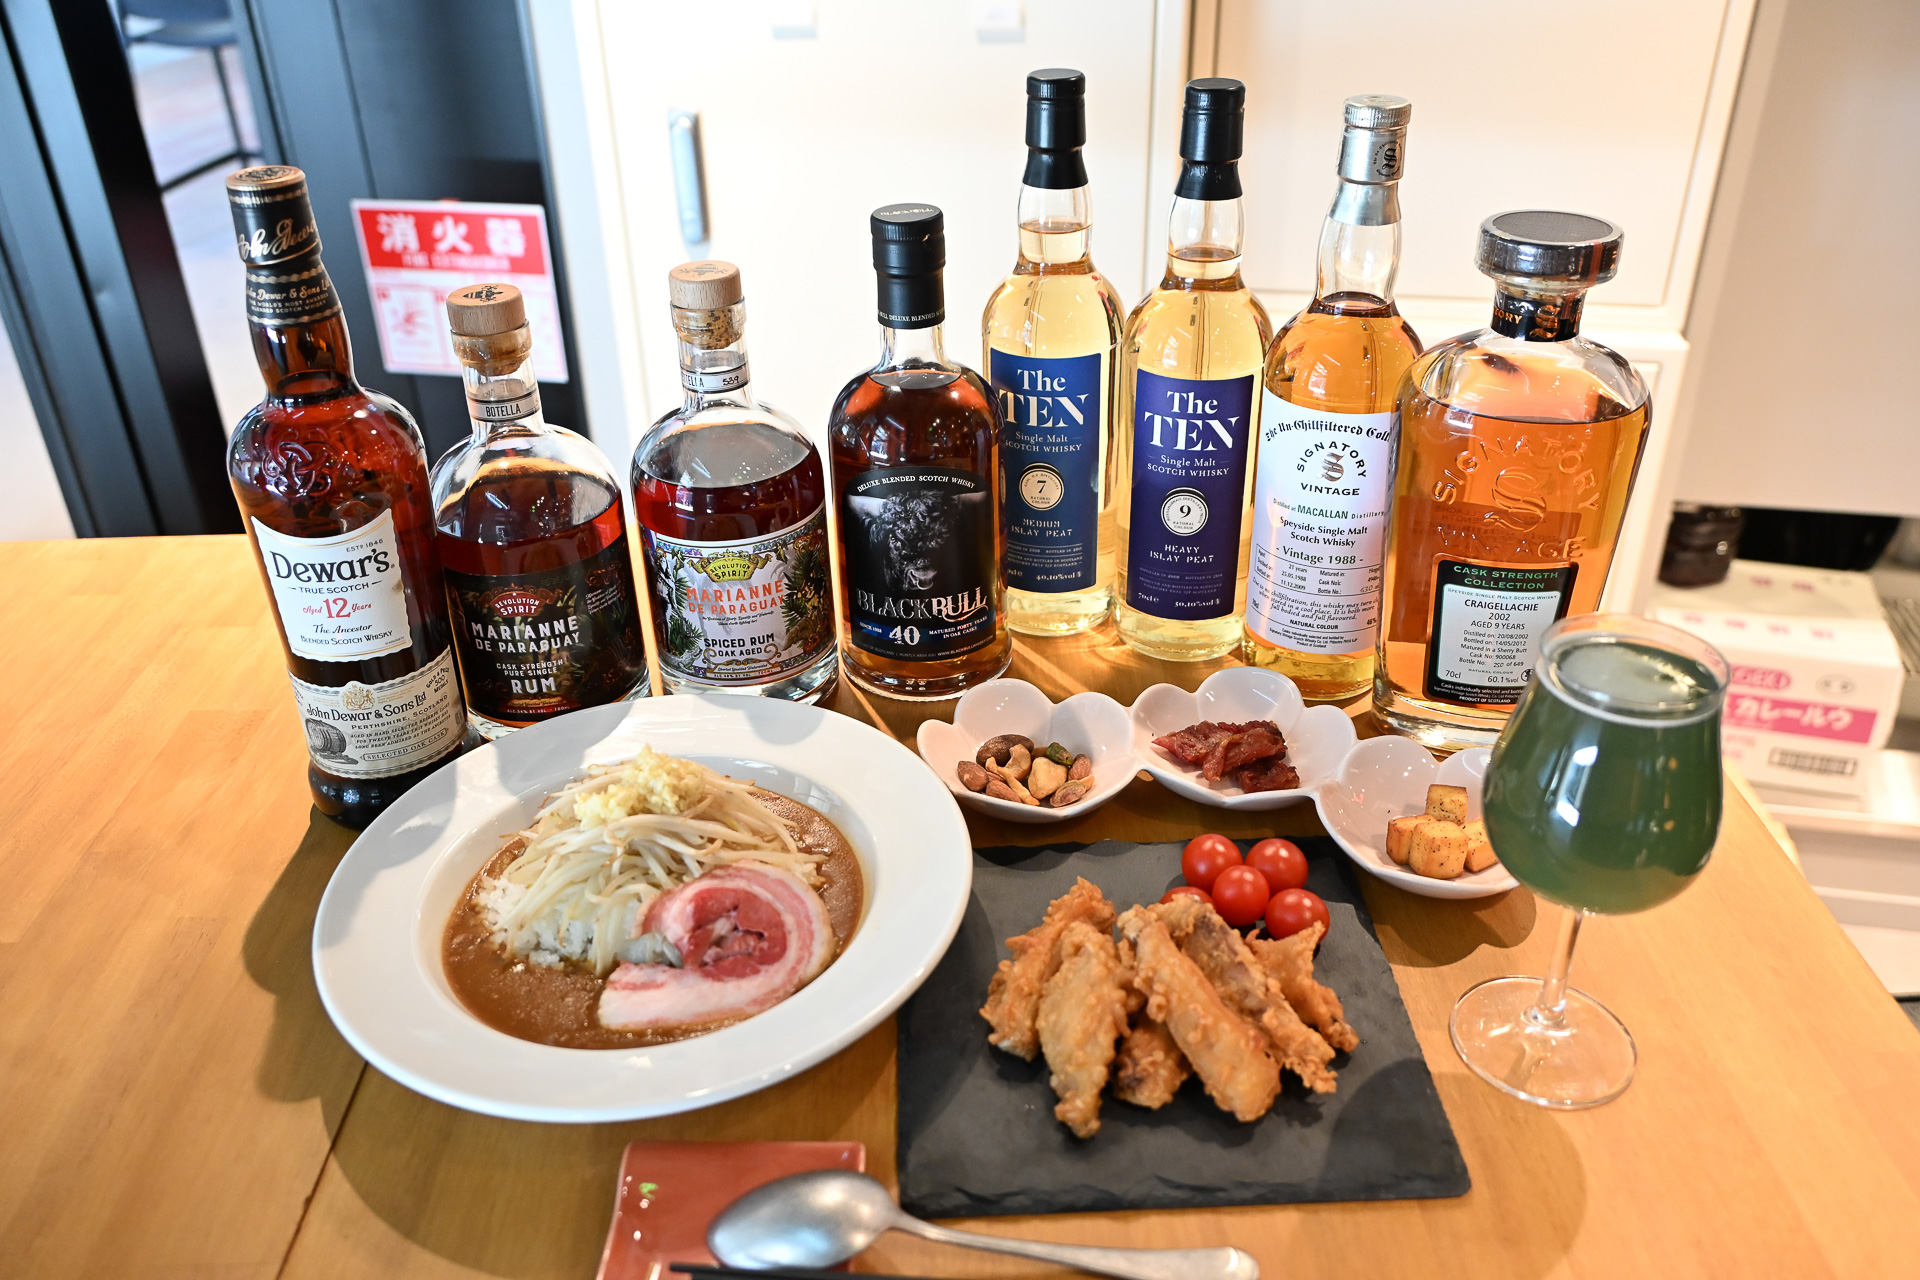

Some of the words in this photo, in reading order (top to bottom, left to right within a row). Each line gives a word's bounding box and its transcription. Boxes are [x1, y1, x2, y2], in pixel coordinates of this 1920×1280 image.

[376, 212, 527, 258] 消火器
[889, 314, 910, 322] DELUXE
[912, 313, 935, 321] BLENDED
[1017, 369, 1067, 392] The
[1000, 389, 1089, 428] TEN
[1166, 390, 1218, 415] The
[486, 404, 521, 417] BOTELLA
[1015, 431, 1043, 443] Single
[1048, 433, 1068, 442] Malt
[1144, 411, 1239, 451] TEN
[1004, 440, 1040, 452] SCOTCH
[1043, 443, 1082, 453] WHISKY
[1161, 454, 1191, 467] Single
[1194, 457, 1216, 466] Malt
[1297, 441, 1366, 478] SIGNATORY
[1147, 462, 1186, 476] SCOTCH
[1190, 467, 1230, 477] WHISKY
[1433, 435, 1599, 510] SIGNATORY
[858, 480, 880, 493] DELUXE
[882, 475, 916, 485] BLENDED
[952, 478, 976, 489] WHISKY
[1037, 480, 1046, 493] 7
[1301, 482, 1360, 496] VINTAGE
[1179, 505, 1191, 518] 9
[1298, 505, 1348, 519] MACALLAN
[1351, 511, 1384, 519] Distillery
[1023, 519, 1060, 528] MEDIUM
[1280, 516, 1315, 532] Speyside
[1318, 526, 1345, 536] Single
[1348, 526, 1368, 535] Malt
[1011, 526, 1039, 536] ISLAY
[1046, 529, 1072, 537] PEAT
[365, 539, 383, 548] 1846
[1291, 532, 1320, 544] Scotch
[1323, 538, 1356, 548] Whisky
[1165, 544, 1200, 553] HEAVY
[1150, 551, 1180, 562] ISLAY
[1187, 555, 1214, 563] PEAT
[1283, 546, 1324, 564] Vintage
[1328, 555, 1356, 565] 1988
[270, 549, 390, 583] Dewar's
[710, 563, 750, 572] REVOLUTION
[1453, 565, 1488, 577] CASK
[1492, 571, 1559, 579] STRENGTH
[715, 570, 748, 579] SPIRIT
[298, 586, 325, 594] TRUE
[326, 582, 369, 594] SCOTCH
[1464, 577, 1545, 589] COLLECTION
[686, 579, 783, 602] MARIANNE
[302, 604, 323, 615] Aged
[323, 597, 352, 619] 12
[352, 603, 372, 612] Years
[495, 598, 540, 608] REVOLUTION
[689, 603, 704, 613] DE
[711, 594, 784, 614] PARAGUAY
[1271, 596, 1287, 605] stored
[1315, 607, 1332, 616] place.
[1323, 602, 1345, 610] whisky
[1464, 599, 1539, 612] CRAIGELLACHIE
[500, 606, 536, 616] SPIRIT
[1489, 613, 1511, 621] 2002
[313, 624, 330, 634] The
[332, 624, 372, 634] Ancestor
[471, 616, 579, 640] MARIANNE
[1290, 619, 1315, 628] NATURAL
[1471, 620, 1493, 629] AGED
[300, 635, 330, 645] BLENDED
[331, 637, 363, 645] SCOTCH
[364, 630, 393, 642] WHISKY
[889, 625, 921, 645] 40
[929, 627, 955, 635] MATURED
[1464, 629, 1486, 638] Distilled
[476, 639, 492, 651] DE
[499, 632, 579, 653] PARAGUAY
[704, 638, 745, 648] SPICED
[750, 633, 774, 646] RUM
[739, 647, 762, 656] AGED
[1461, 644, 1484, 652] Matured
[521, 659, 563, 670] STRENGTH
[1459, 657, 1475, 665] Bottle
[528, 667, 557, 676] SINGLE
[1445, 670, 1462, 679] 70cl
[511, 677, 556, 694] RUM
[307, 704, 330, 720] John
[331, 709, 372, 721] Dewar
[375, 709, 383, 719] &
[383, 700, 414, 717] Sons
[415, 692, 426, 706] Ltd
[352, 717, 410, 730] PERTHSHIRE,
[413, 694, 448, 717] SCOTLAND
[367, 748, 408, 760] SELECTED
[411, 743, 426, 751] OAK
[429, 731, 445, 743] CASK
